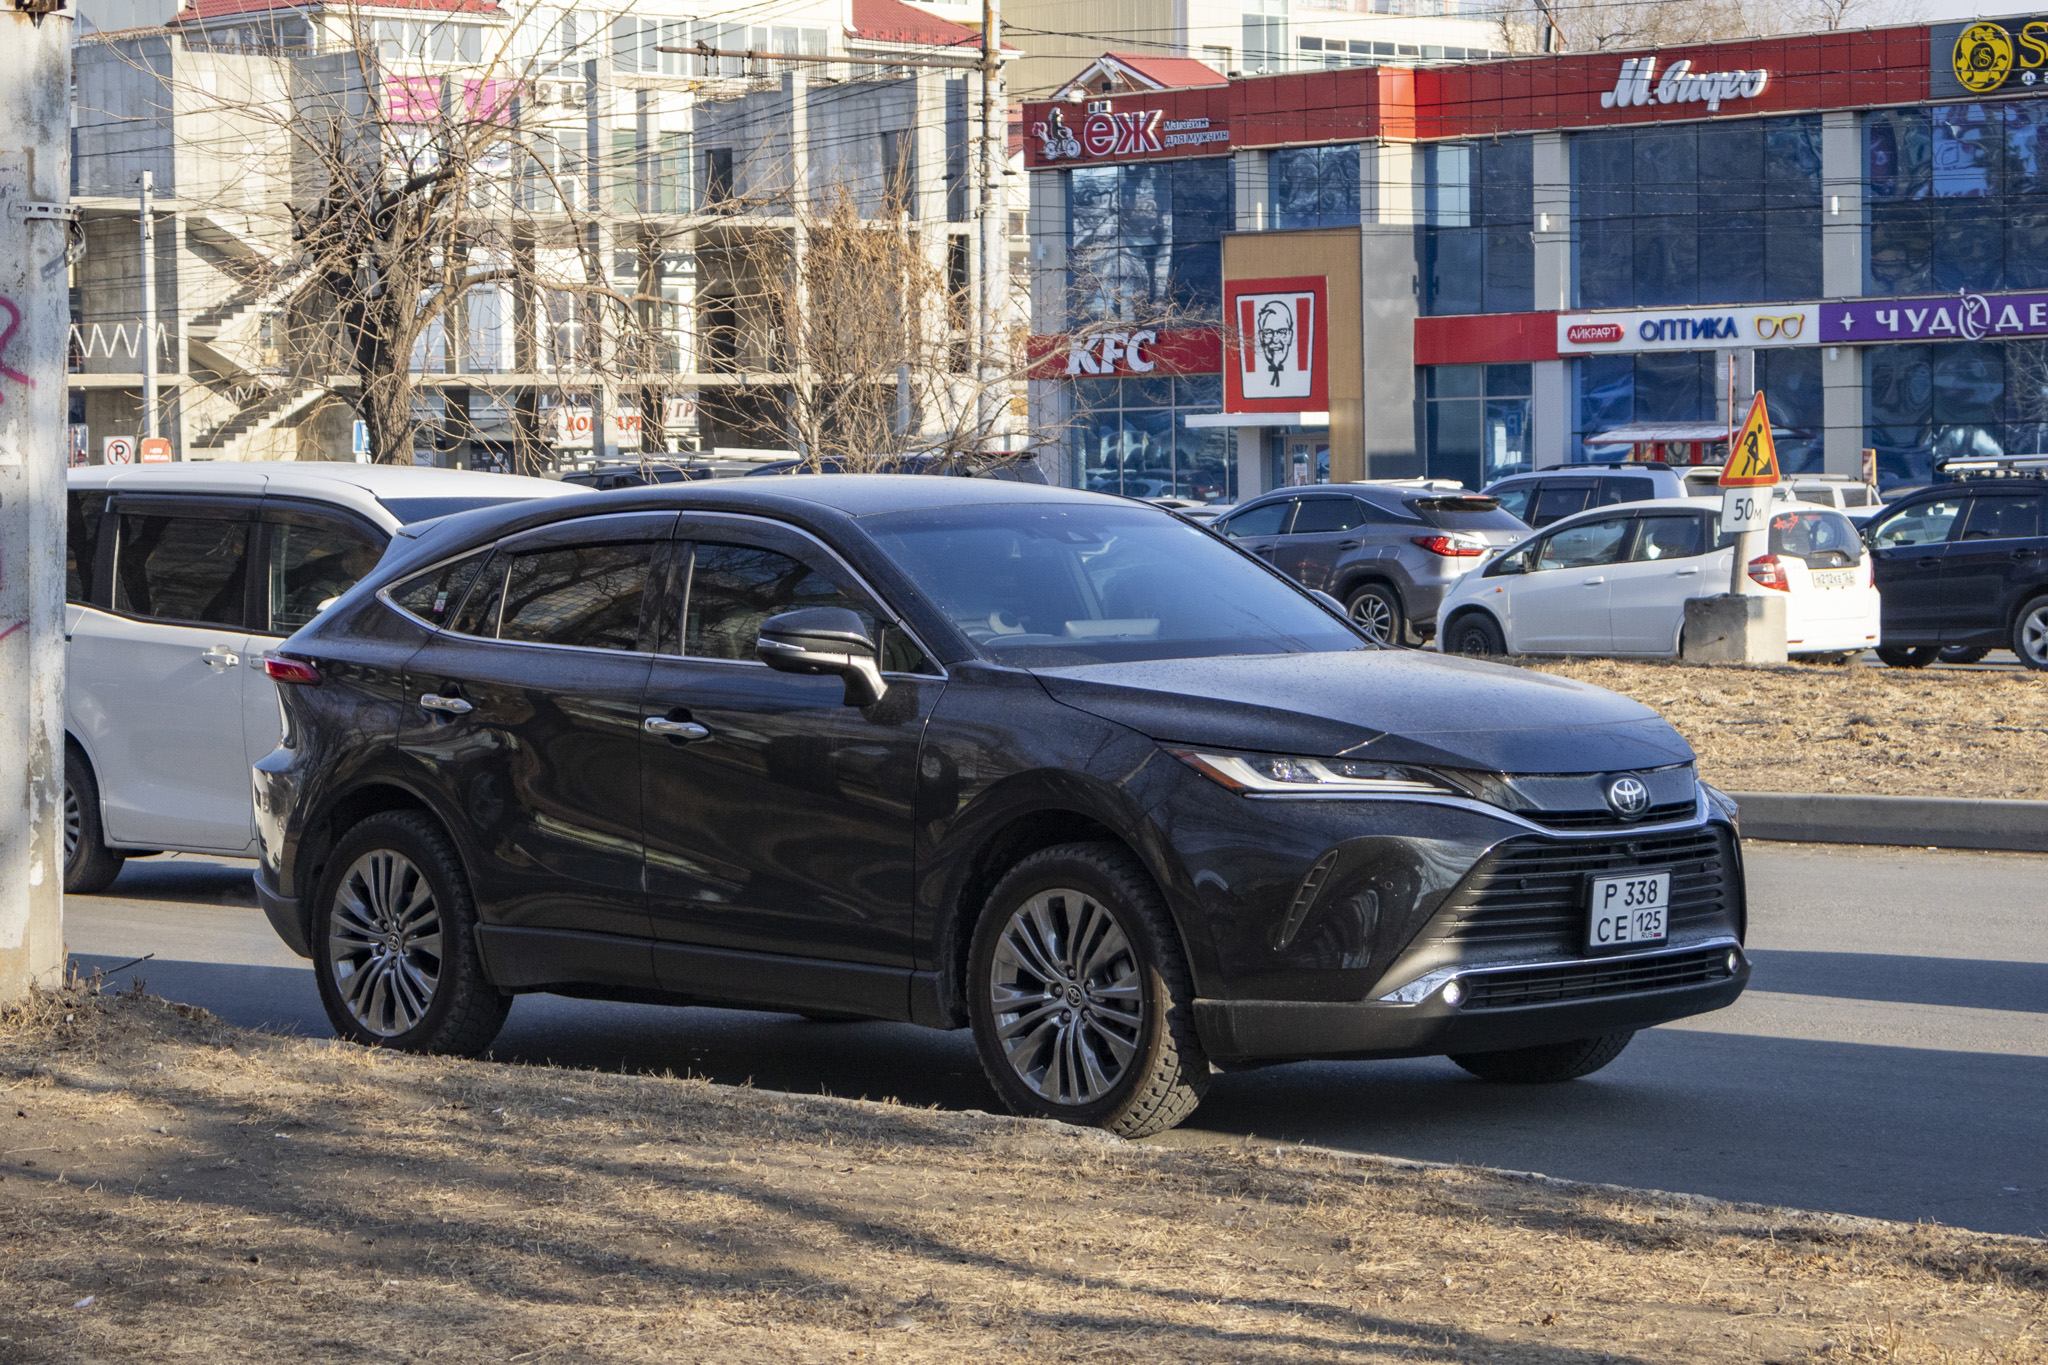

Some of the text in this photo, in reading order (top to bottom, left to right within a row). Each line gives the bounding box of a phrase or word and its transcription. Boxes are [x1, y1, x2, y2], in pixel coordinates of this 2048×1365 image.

[1601, 56, 1767, 112] М.видео
[1164, 130, 1229, 146] для мужчин
[1570, 326, 1618, 340] АЙКРАФТ
[1639, 316, 1739, 342] ОПТИКА
[1065, 330, 1157, 375] KFC
[1604, 879, 1658, 910] Р 338
[1597, 910, 1662, 943] СЕ 125
[1641, 931, 1654, 939] RUS
